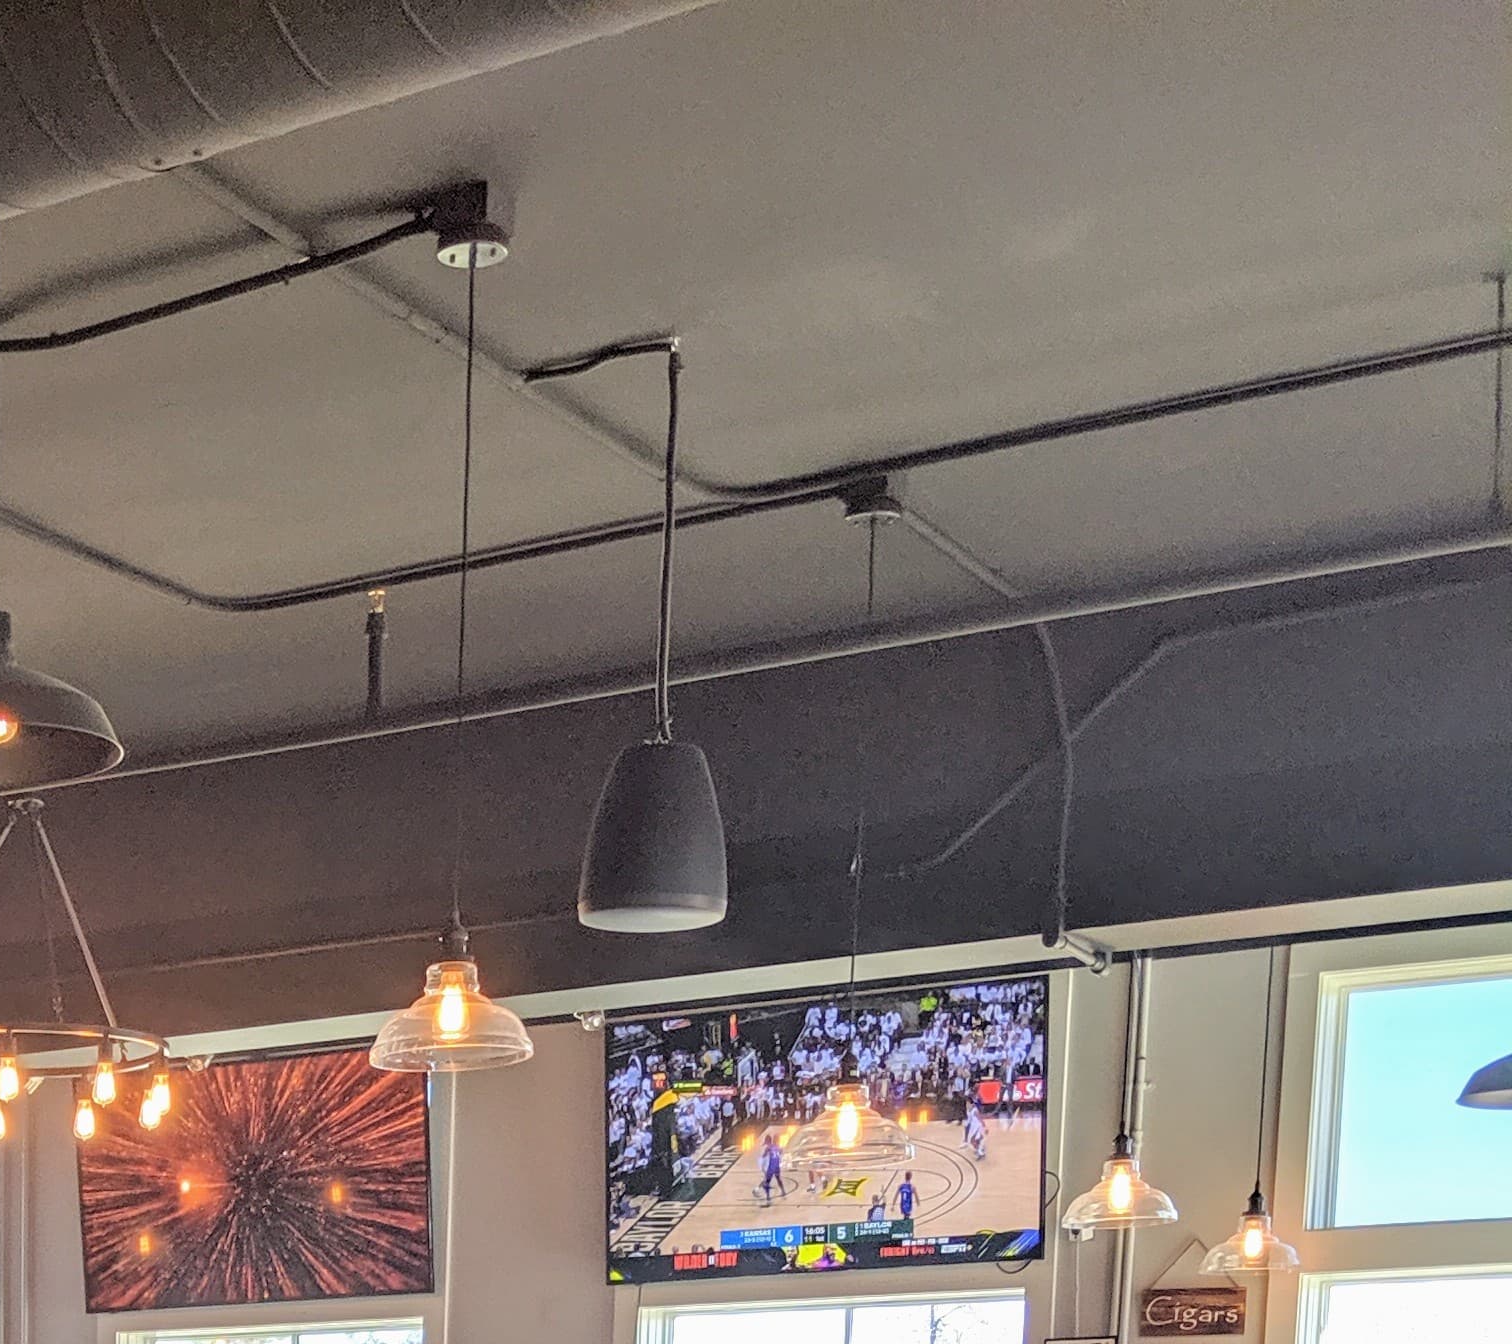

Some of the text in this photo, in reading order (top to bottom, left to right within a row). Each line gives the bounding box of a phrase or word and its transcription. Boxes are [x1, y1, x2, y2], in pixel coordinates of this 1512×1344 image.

[784, 1229, 794, 1243] 6
[804, 1226, 825, 1235] 16:05
[836, 1226, 847, 1240] 5
[1145, 1295, 1238, 1330] Cigars
